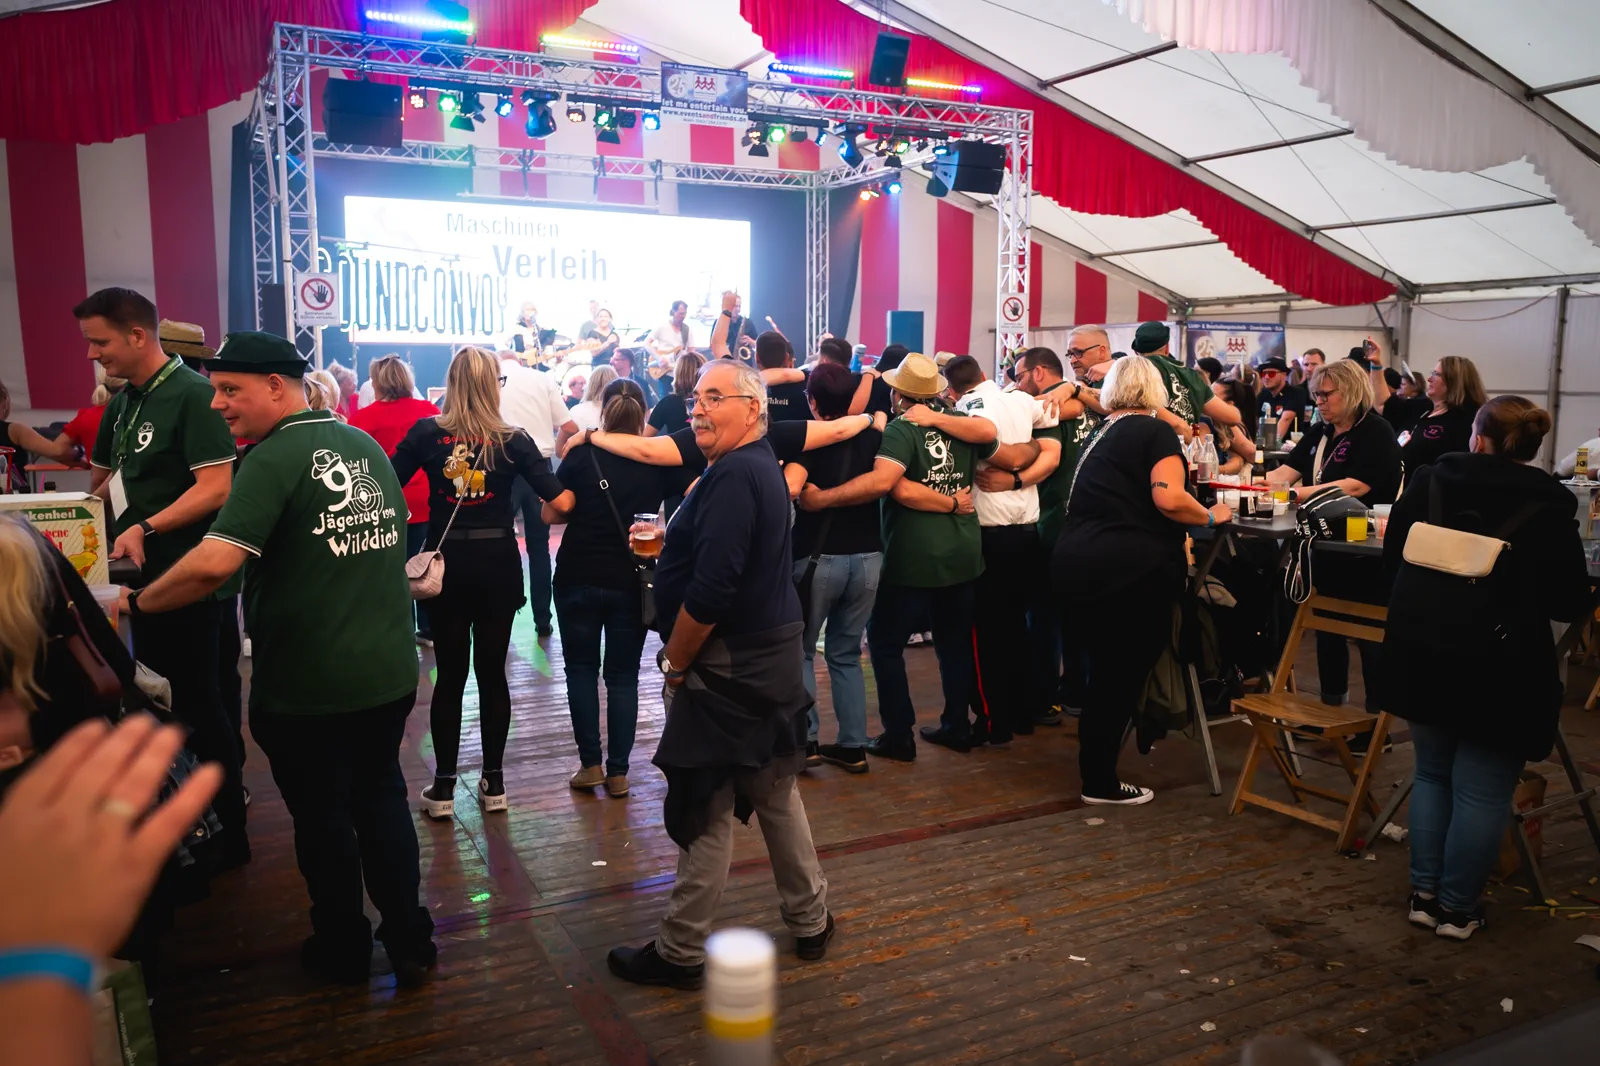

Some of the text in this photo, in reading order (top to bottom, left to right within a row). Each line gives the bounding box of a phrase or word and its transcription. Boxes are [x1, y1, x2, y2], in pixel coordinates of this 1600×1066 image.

[662, 98, 673, 106] let
[690, 101, 728, 112] entertain
[662, 109, 747, 122] www.eventsandfriends.de
[445, 213, 560, 239] Maschinen
[492, 244, 608, 281] Verleih
[312, 510, 380, 535] Jägerzug
[326, 524, 398, 557] Wilddieb
